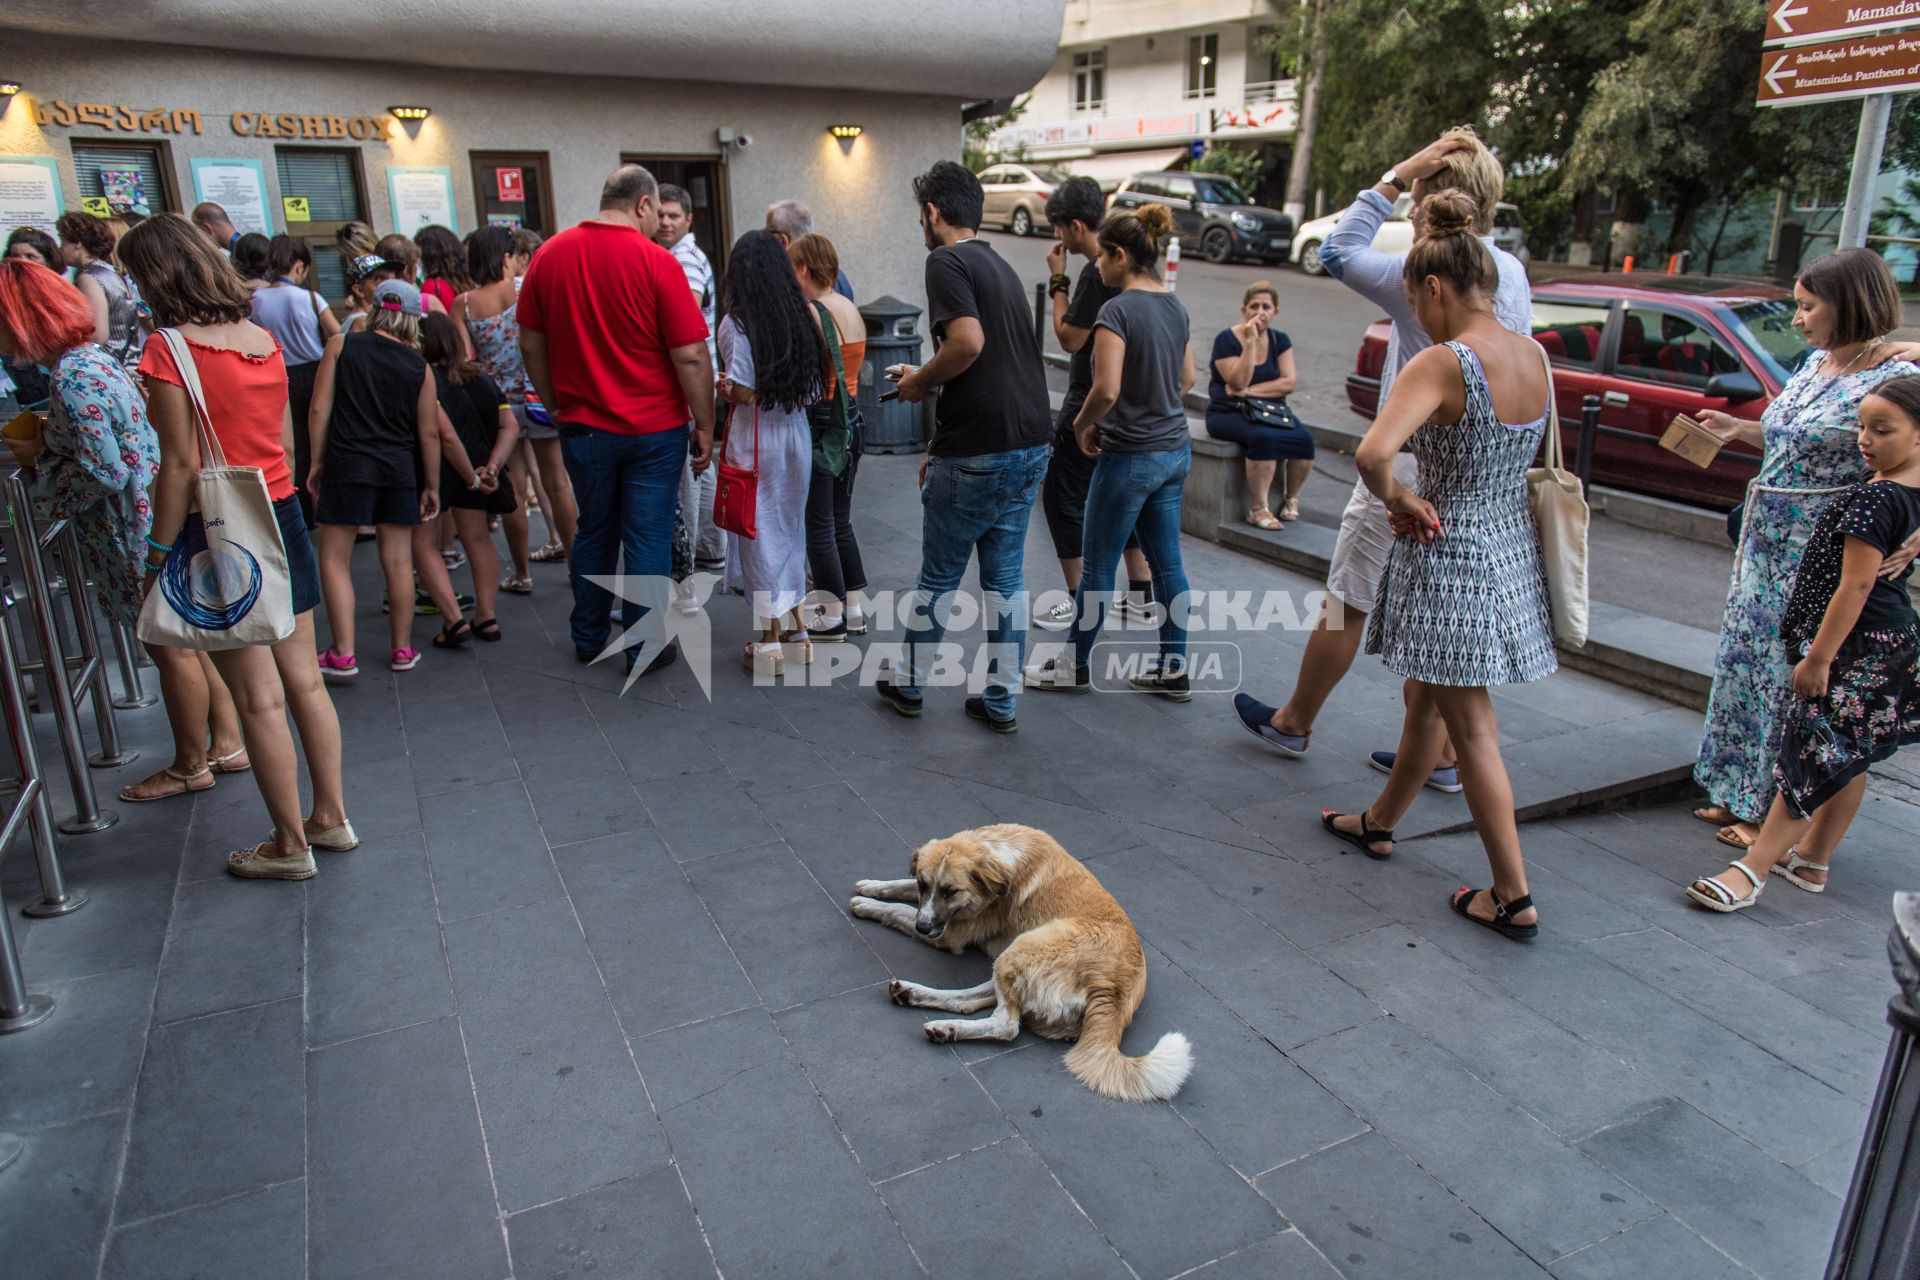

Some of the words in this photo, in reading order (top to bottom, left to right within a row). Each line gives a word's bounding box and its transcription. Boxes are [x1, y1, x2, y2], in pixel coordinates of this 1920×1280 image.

[1795, 73, 1852, 88] Mtatsminda
[1855, 67, 1904, 81] Pantheon
[1908, 63, 1920, 74] of
[30, 99, 204, 135] სალარო
[231, 111, 394, 141] CASHBOX
